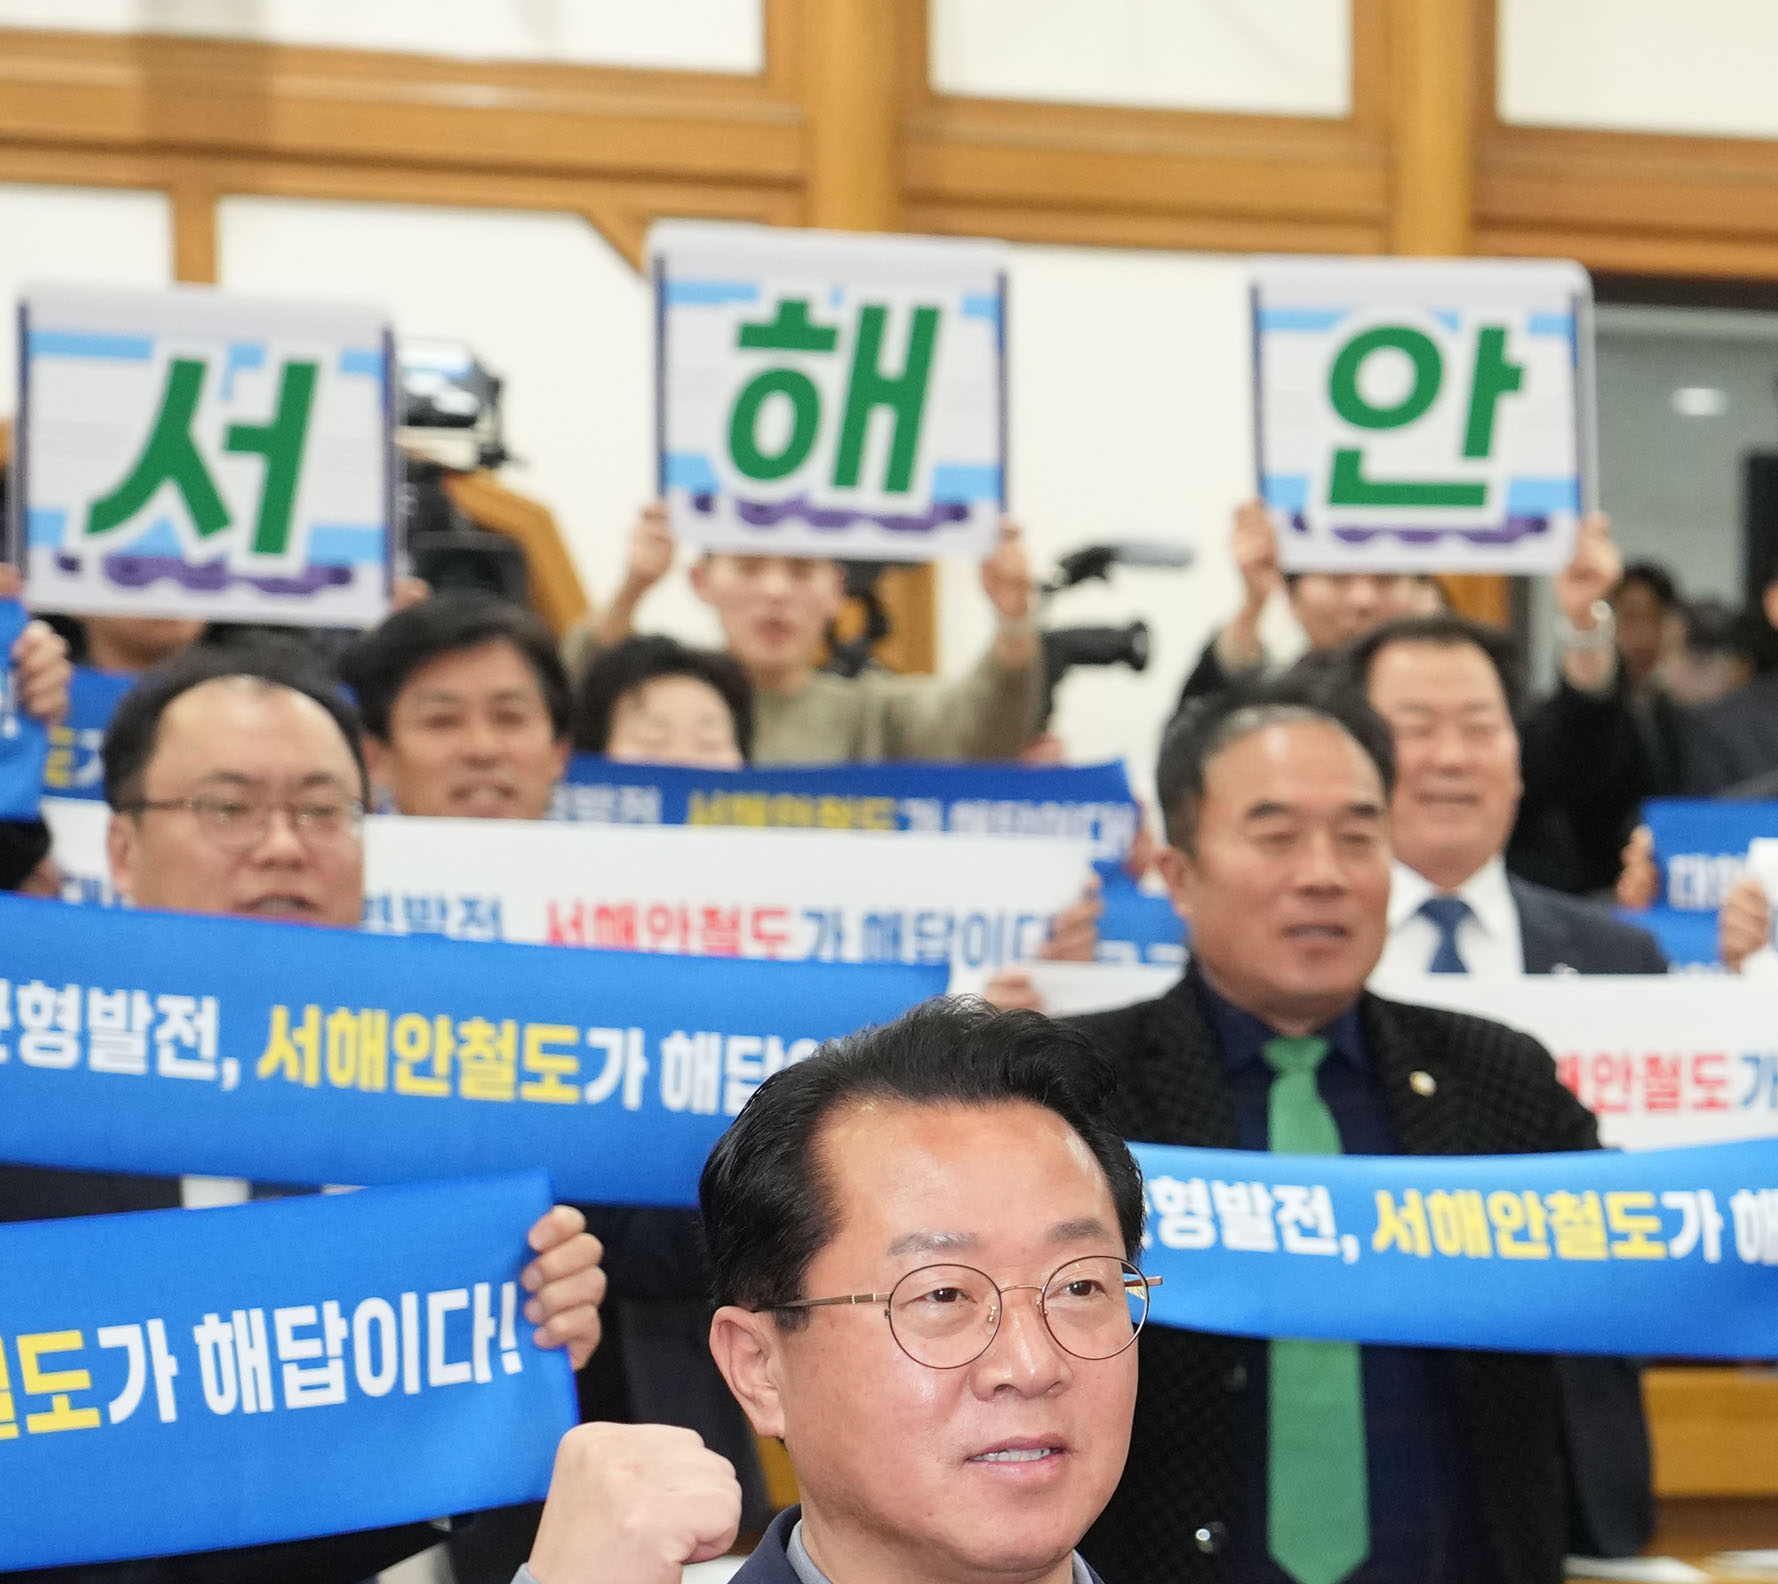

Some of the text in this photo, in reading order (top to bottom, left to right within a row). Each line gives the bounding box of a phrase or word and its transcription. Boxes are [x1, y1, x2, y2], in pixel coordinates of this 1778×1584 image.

[86, 359, 320, 555] 서
[727, 297, 943, 494] 해
[1326, 324, 1524, 508] 안
[257, 1004, 649, 1111] 서해안철도가
[1143, 1175, 1360, 1264] 형발전,
[1372, 1187, 1723, 1263] 서해안철도가
[195, 1281, 523, 1417] 해답이다!
